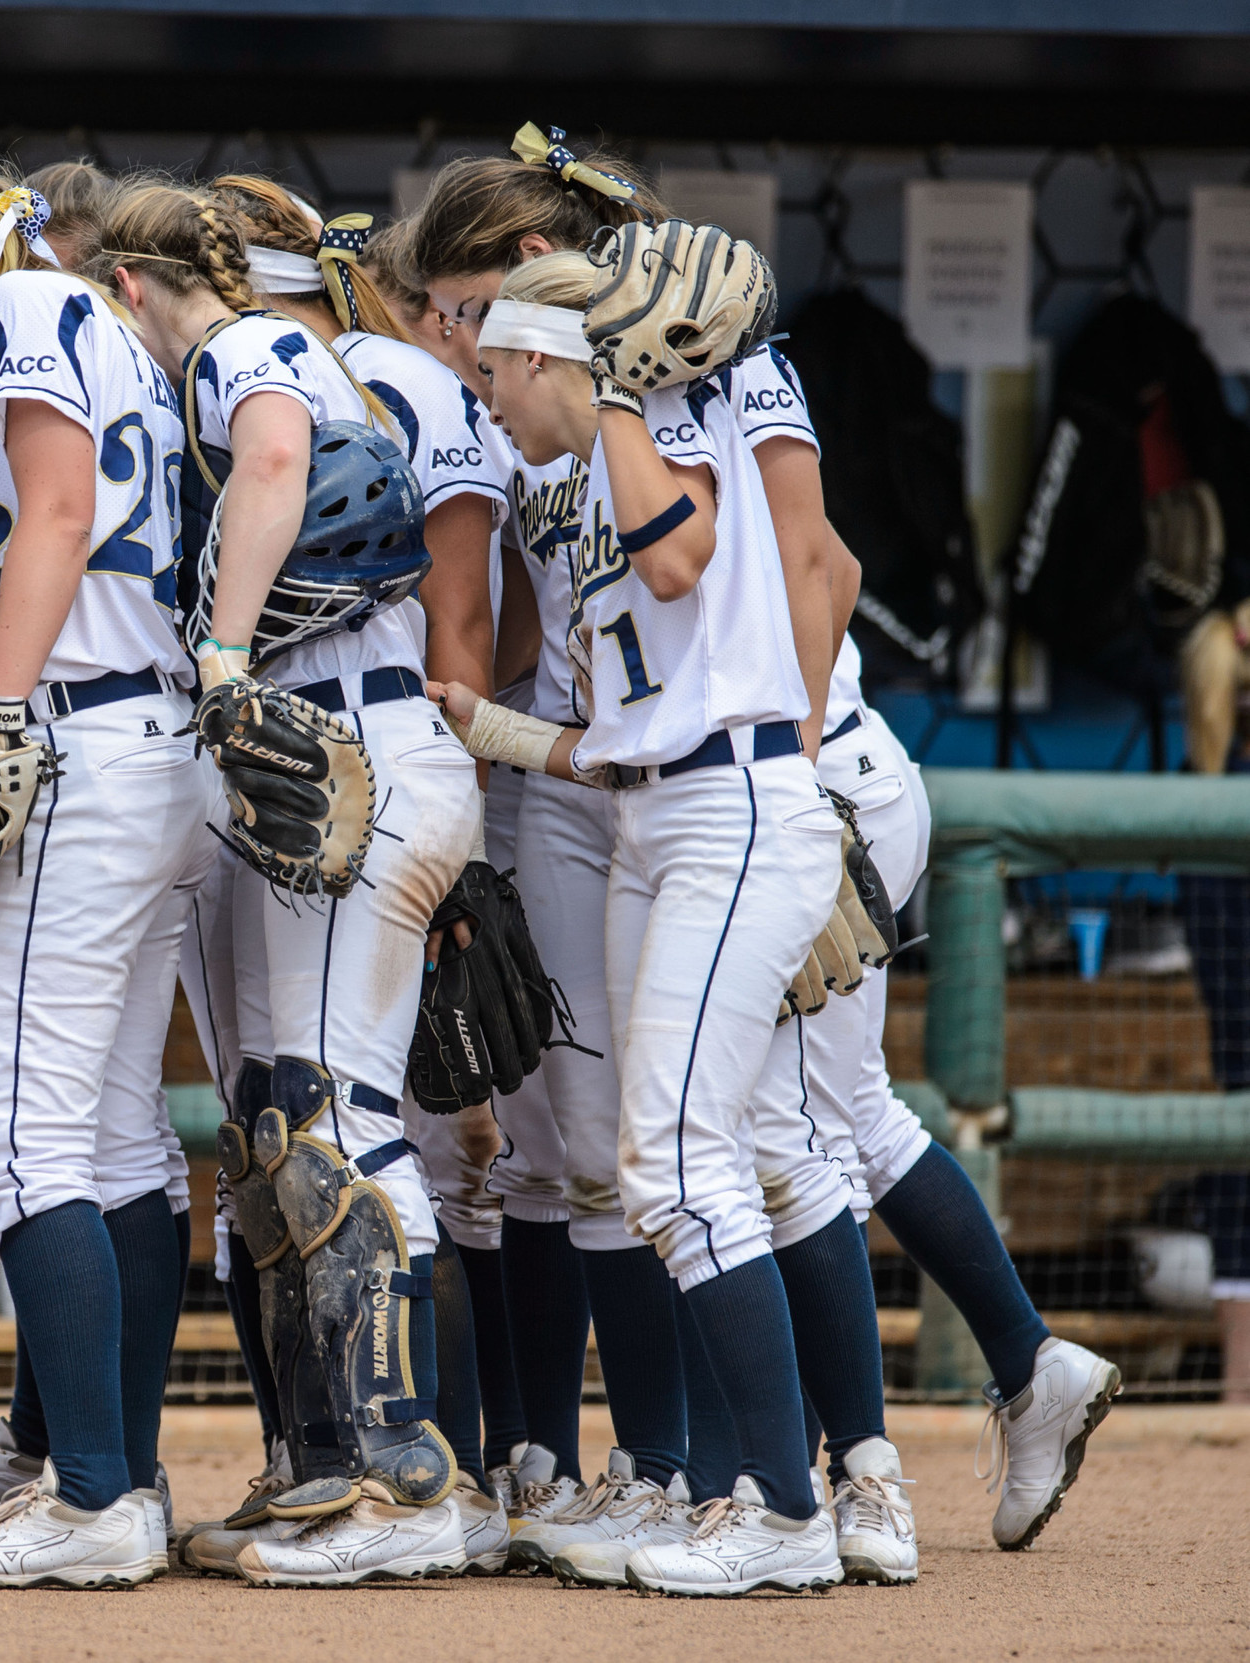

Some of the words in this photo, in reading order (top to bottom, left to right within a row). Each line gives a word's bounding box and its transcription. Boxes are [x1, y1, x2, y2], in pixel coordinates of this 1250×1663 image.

[225, 361, 271, 400] ACC
[743, 388, 794, 413] ACC
[654, 423, 696, 446] CC
[431, 447, 483, 469] ACC
[600, 609, 664, 709] 1
[225, 734, 315, 773] WORTH
[453, 1008, 481, 1076] WORTH
[372, 1310, 390, 1380] WORTH
